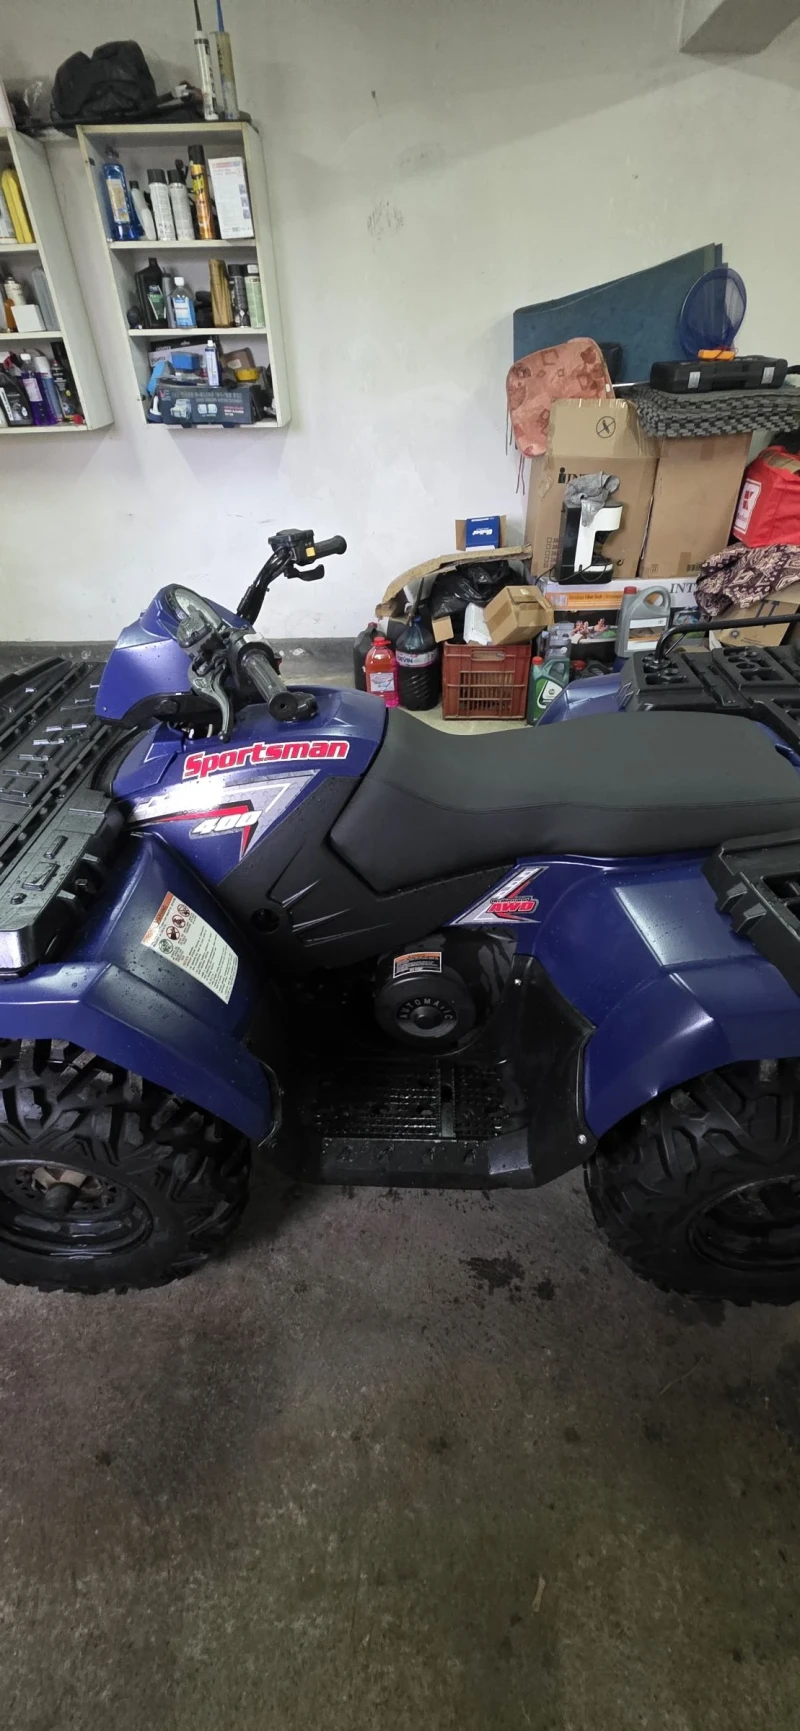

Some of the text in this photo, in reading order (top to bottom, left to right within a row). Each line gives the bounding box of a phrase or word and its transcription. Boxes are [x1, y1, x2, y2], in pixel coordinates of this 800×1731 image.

[182, 740, 350, 780] Sportsman
[191, 810, 263, 836] 400
[487, 900, 536, 913] AWD
